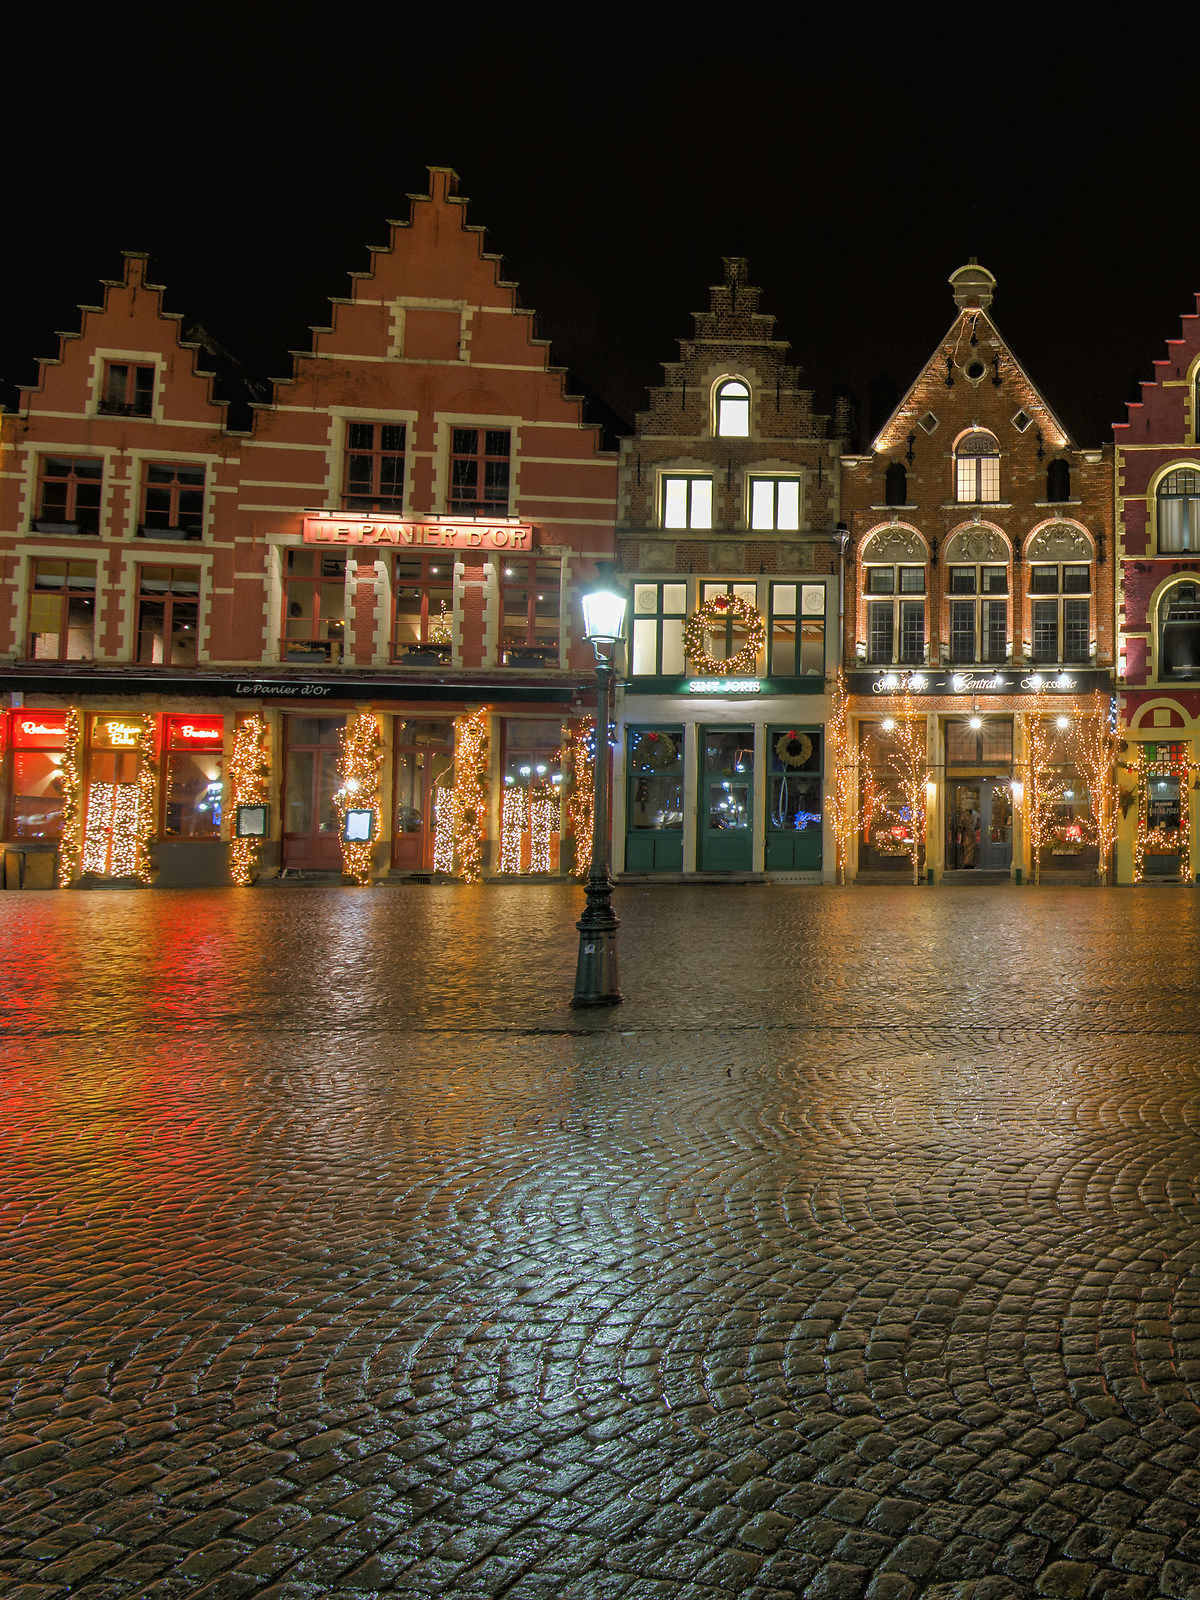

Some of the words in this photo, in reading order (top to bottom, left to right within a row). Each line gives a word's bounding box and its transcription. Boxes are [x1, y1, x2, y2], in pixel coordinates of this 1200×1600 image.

[315, 525, 349, 542] LE
[357, 522, 457, 545] PANIER
[466, 527, 527, 548] D'OR
[236, 683, 253, 693] Le
[253, 684, 299, 694] Panier
[301, 684, 331, 695] d'Or
[689, 681, 720, 693] SINT
[722, 681, 761, 693] JORIS
[952, 672, 998, 693] Central
